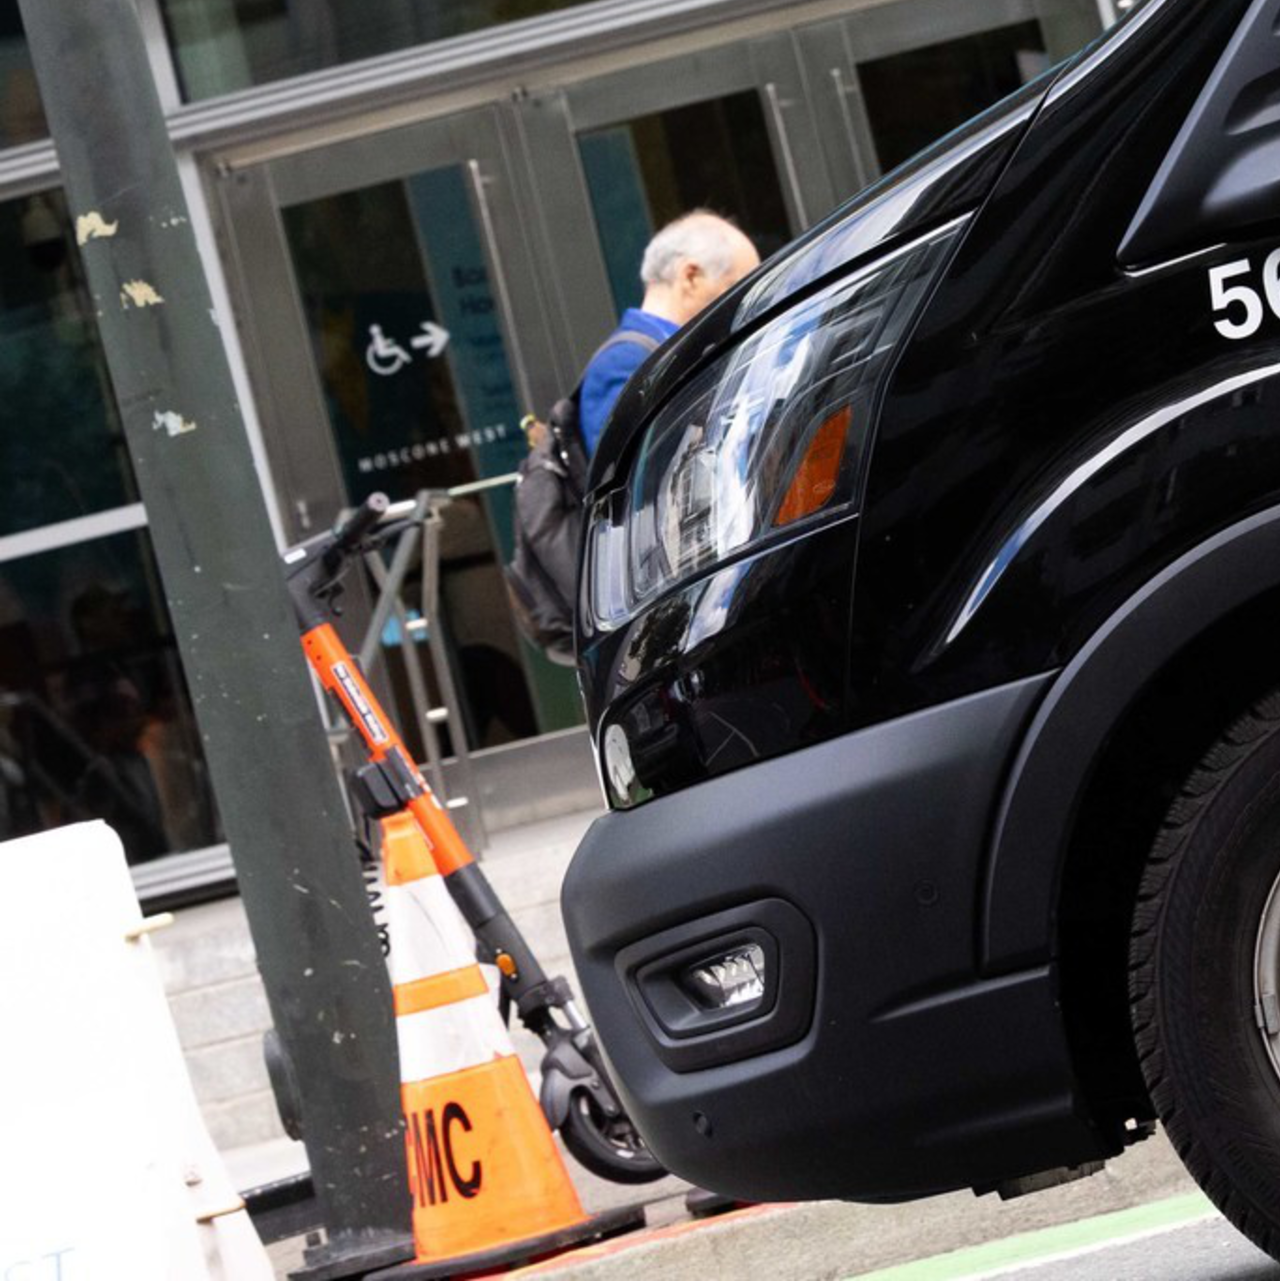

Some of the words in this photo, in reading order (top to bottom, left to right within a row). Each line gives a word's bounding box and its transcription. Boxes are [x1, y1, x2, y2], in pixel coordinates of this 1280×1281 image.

[358, 437, 450, 472] MOSCONE
[454, 424, 507, 449] WEST
[405, 1101, 483, 1208] MC
